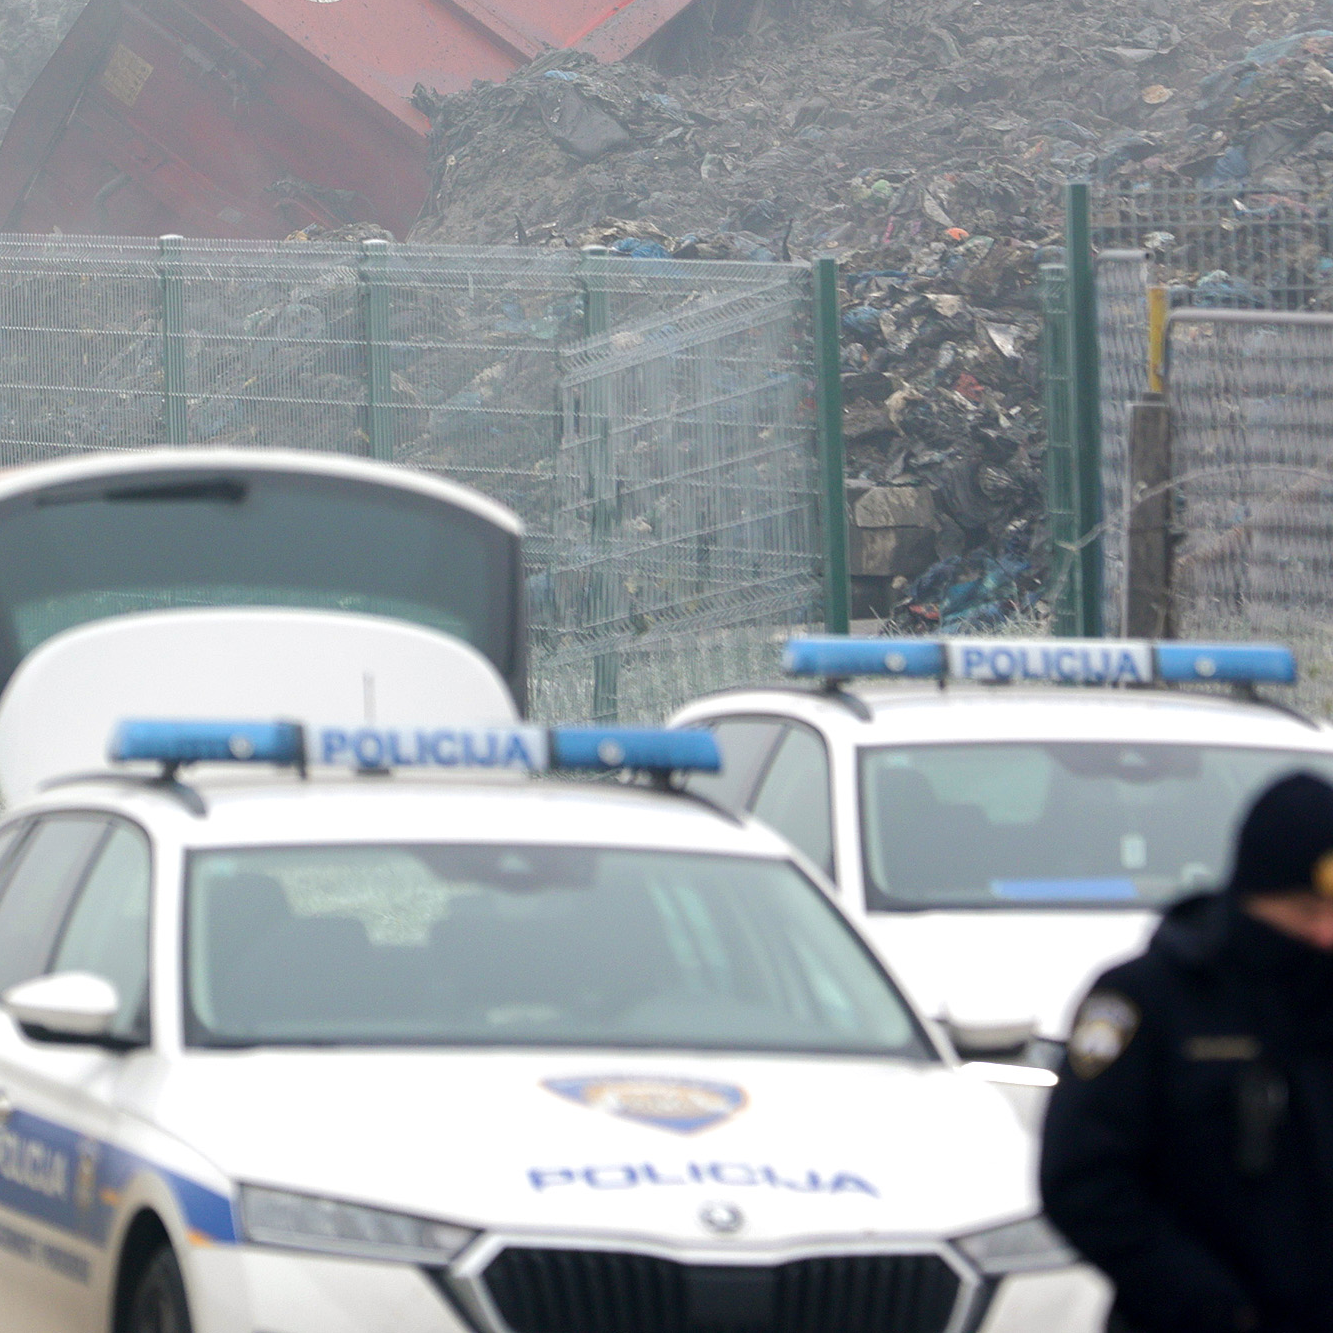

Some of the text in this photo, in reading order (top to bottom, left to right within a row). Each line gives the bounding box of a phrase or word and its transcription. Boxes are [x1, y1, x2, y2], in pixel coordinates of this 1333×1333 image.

[960, 645, 1143, 681] POLICIJA
[320, 726, 531, 768] POLICIJA
[526, 1160, 882, 1200] POLICIJA
